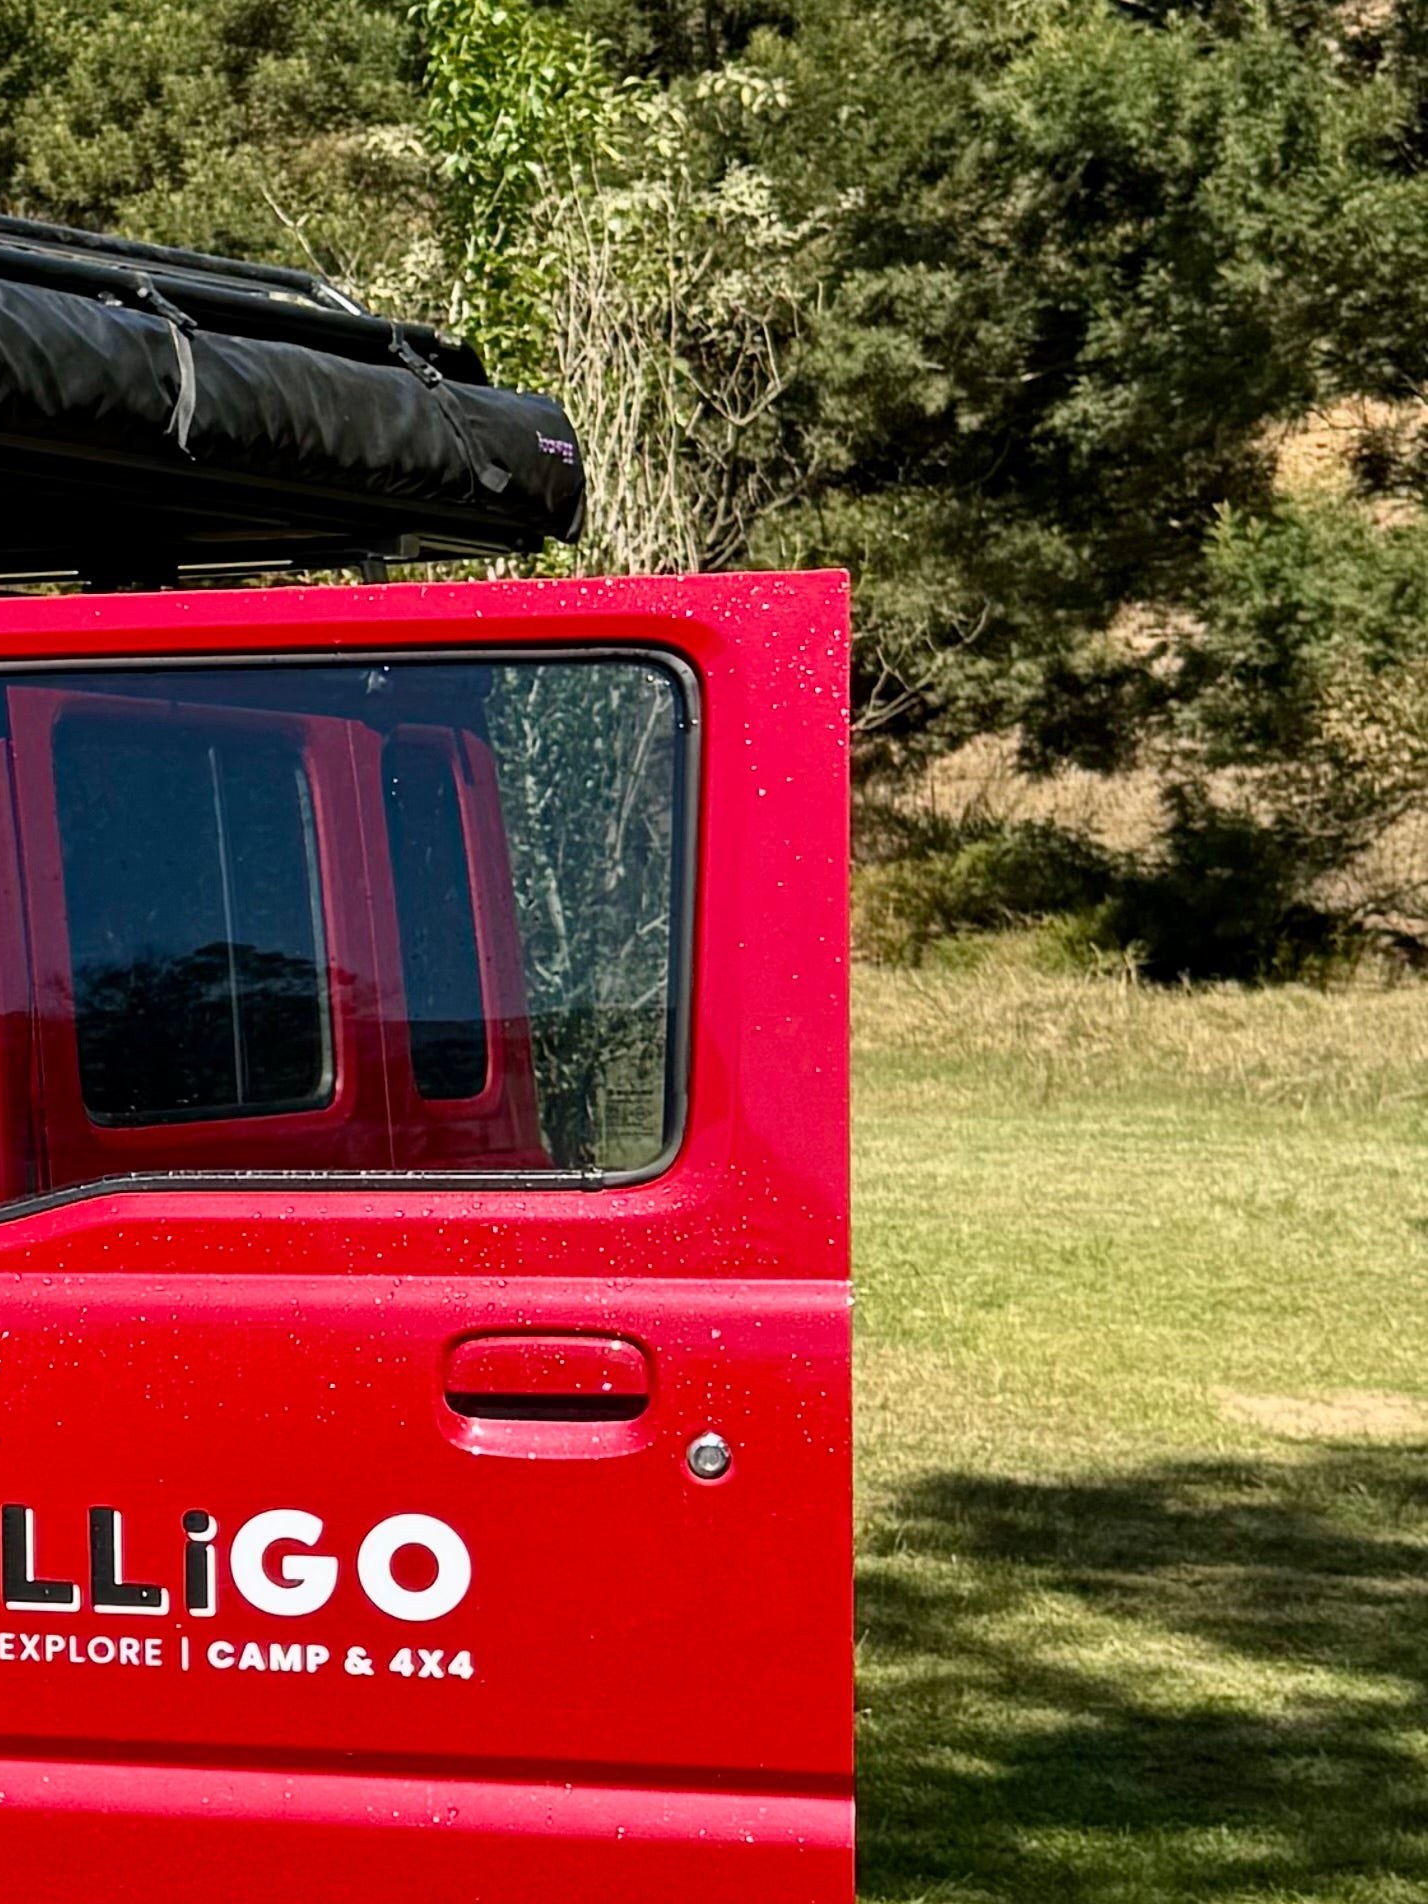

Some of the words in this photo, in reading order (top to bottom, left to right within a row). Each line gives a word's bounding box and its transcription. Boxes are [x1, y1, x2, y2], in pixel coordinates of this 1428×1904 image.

[207, 1640, 330, 1675] CAMP
[343, 1646, 375, 1677] &
[388, 1648, 475, 1681] 4X4
